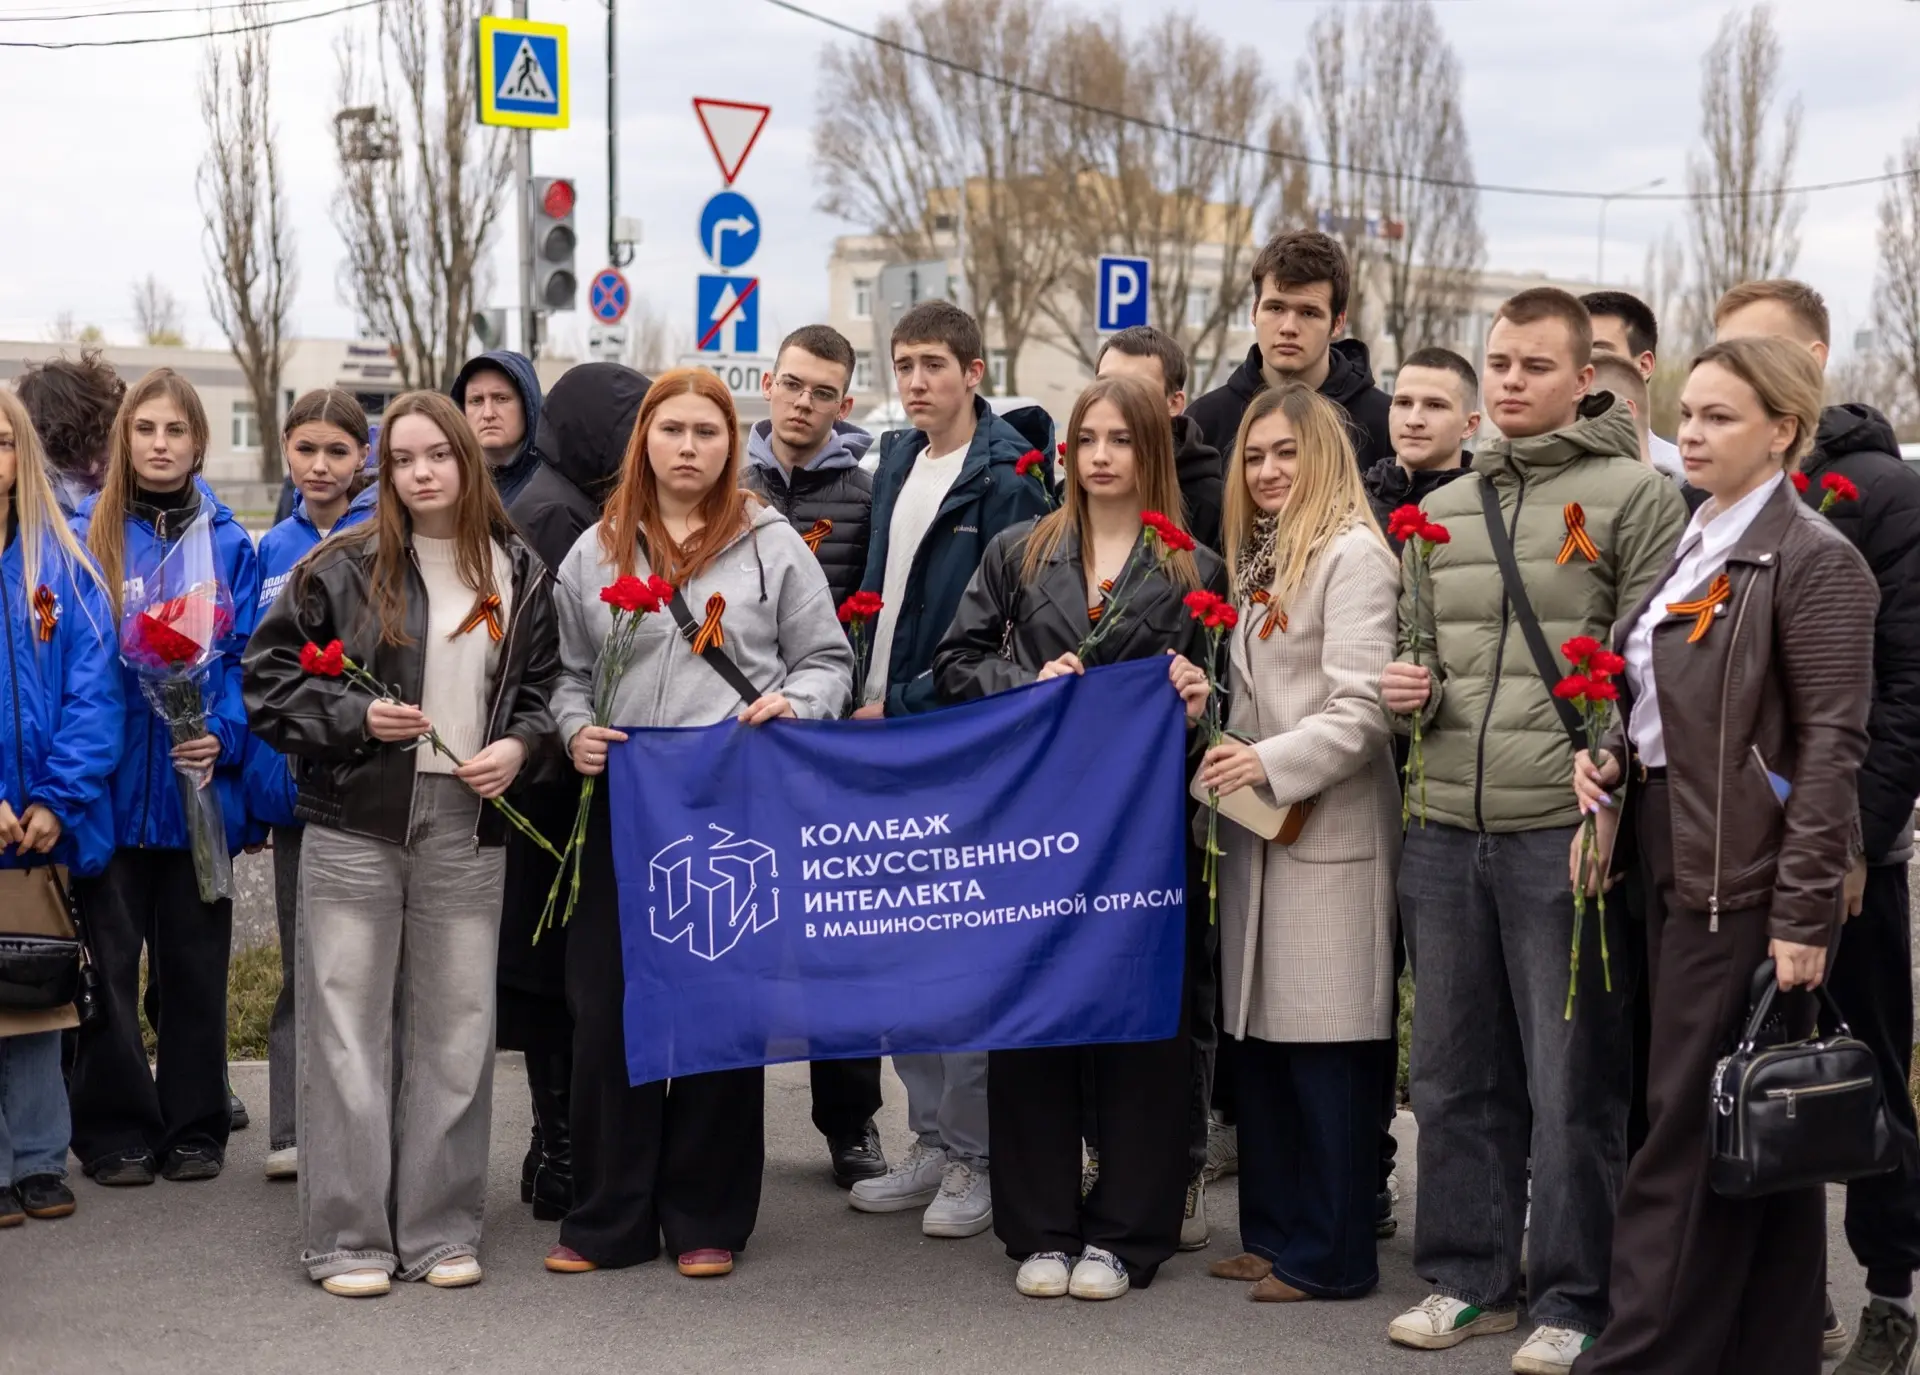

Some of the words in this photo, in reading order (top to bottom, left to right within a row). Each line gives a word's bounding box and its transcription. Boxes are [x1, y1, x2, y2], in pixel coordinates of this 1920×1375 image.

[1108, 264, 1140, 325] P
[699, 364, 761, 391] ТОП
[800, 813, 951, 848] КОЛЛЕДЖ
[802, 831, 1080, 881] ИСКУССТВЕННОГО
[804, 879, 986, 914] ИНТЕЛЛЕКТА
[805, 923, 817, 938] В
[823, 893, 1087, 938] МАШИНОСТРОИТЕЛЬНОЙ
[1093, 888, 1183, 912] ОТРАСЛИ
